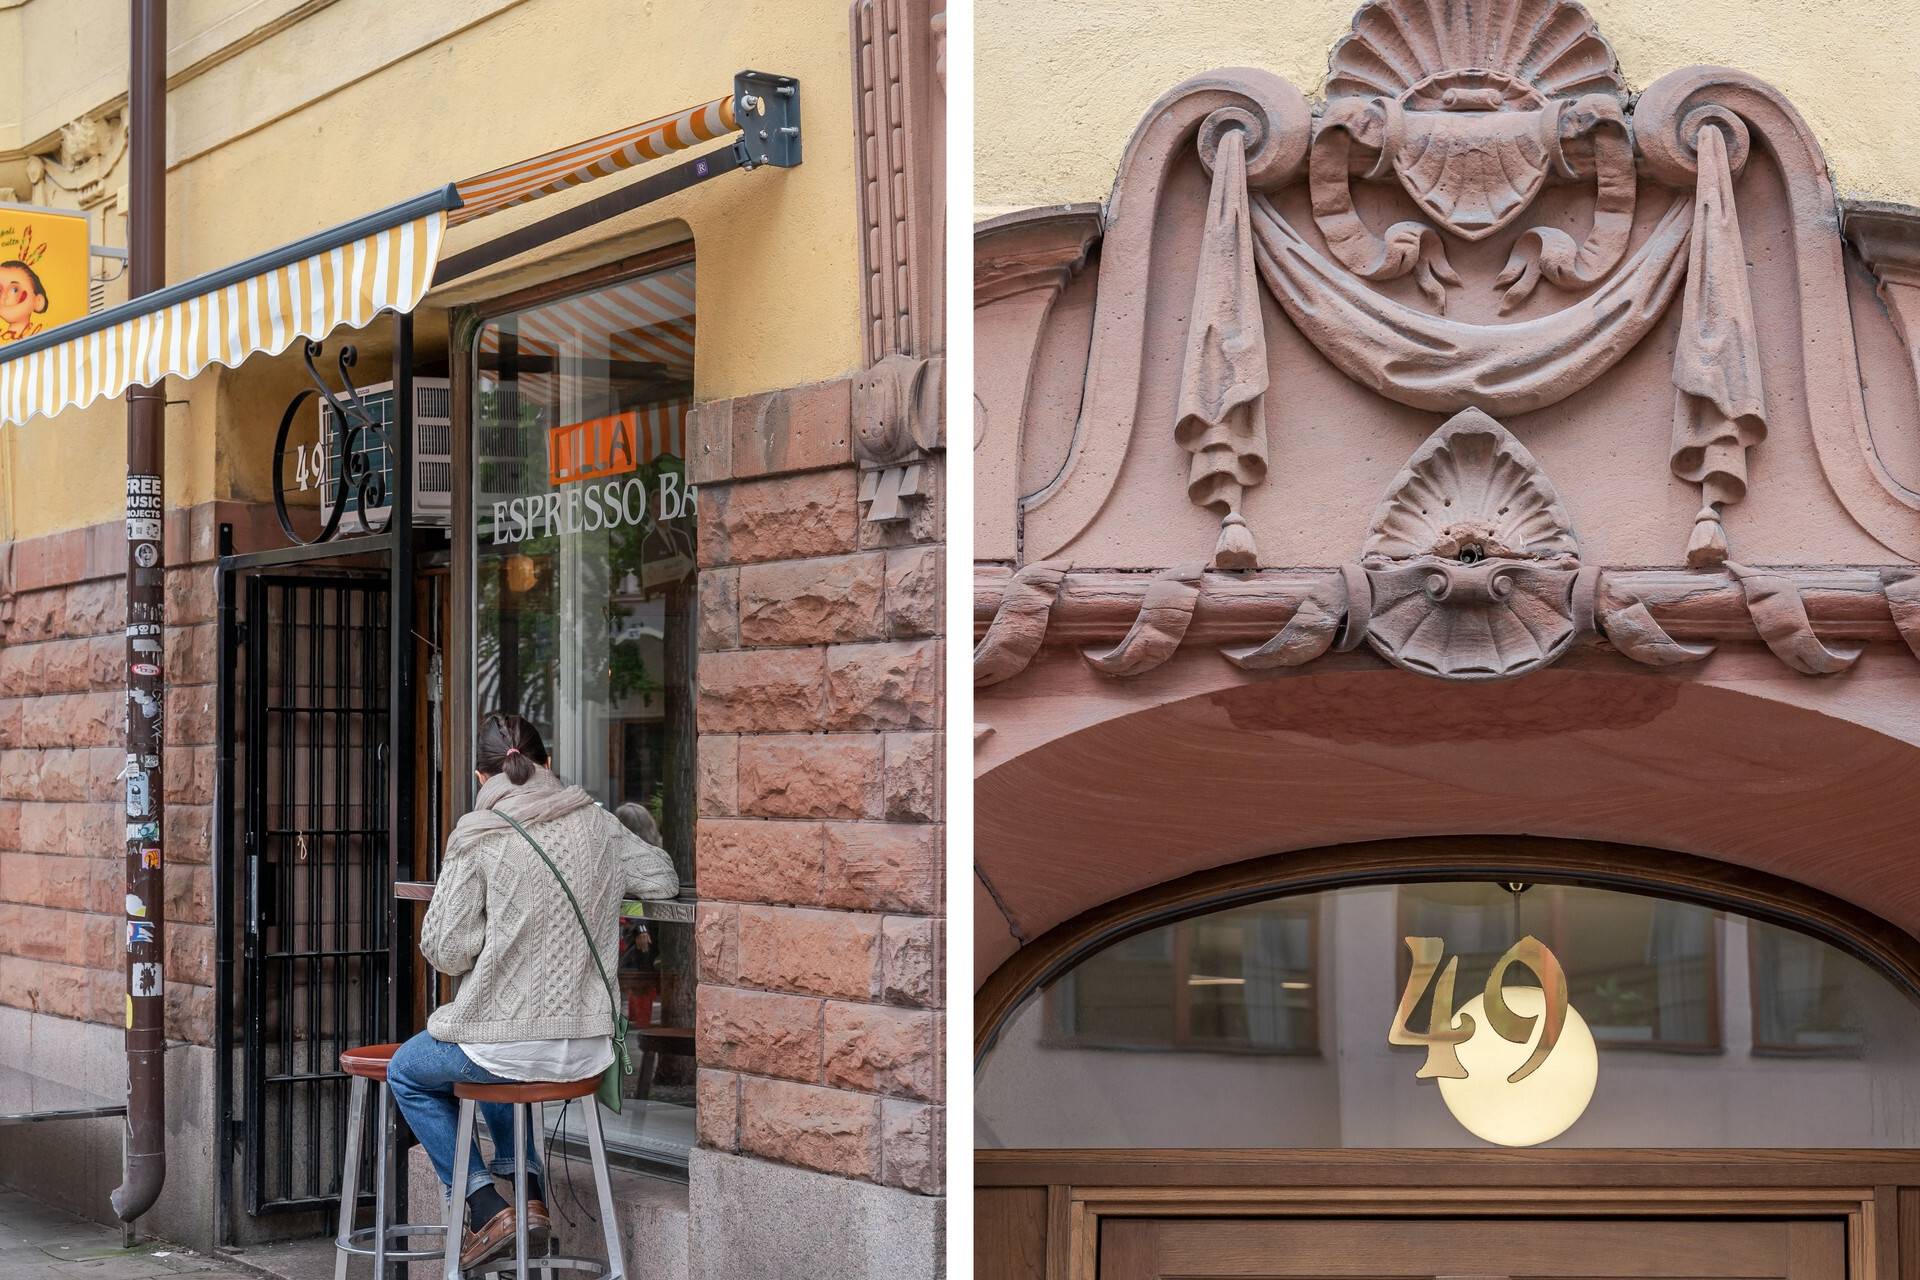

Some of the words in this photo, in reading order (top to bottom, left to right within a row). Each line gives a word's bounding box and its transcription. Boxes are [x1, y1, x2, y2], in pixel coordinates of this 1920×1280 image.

[295, 441, 325, 492] 49
[491, 477, 647, 546] ESPRESSO
[1388, 934, 1569, 1084] 49
